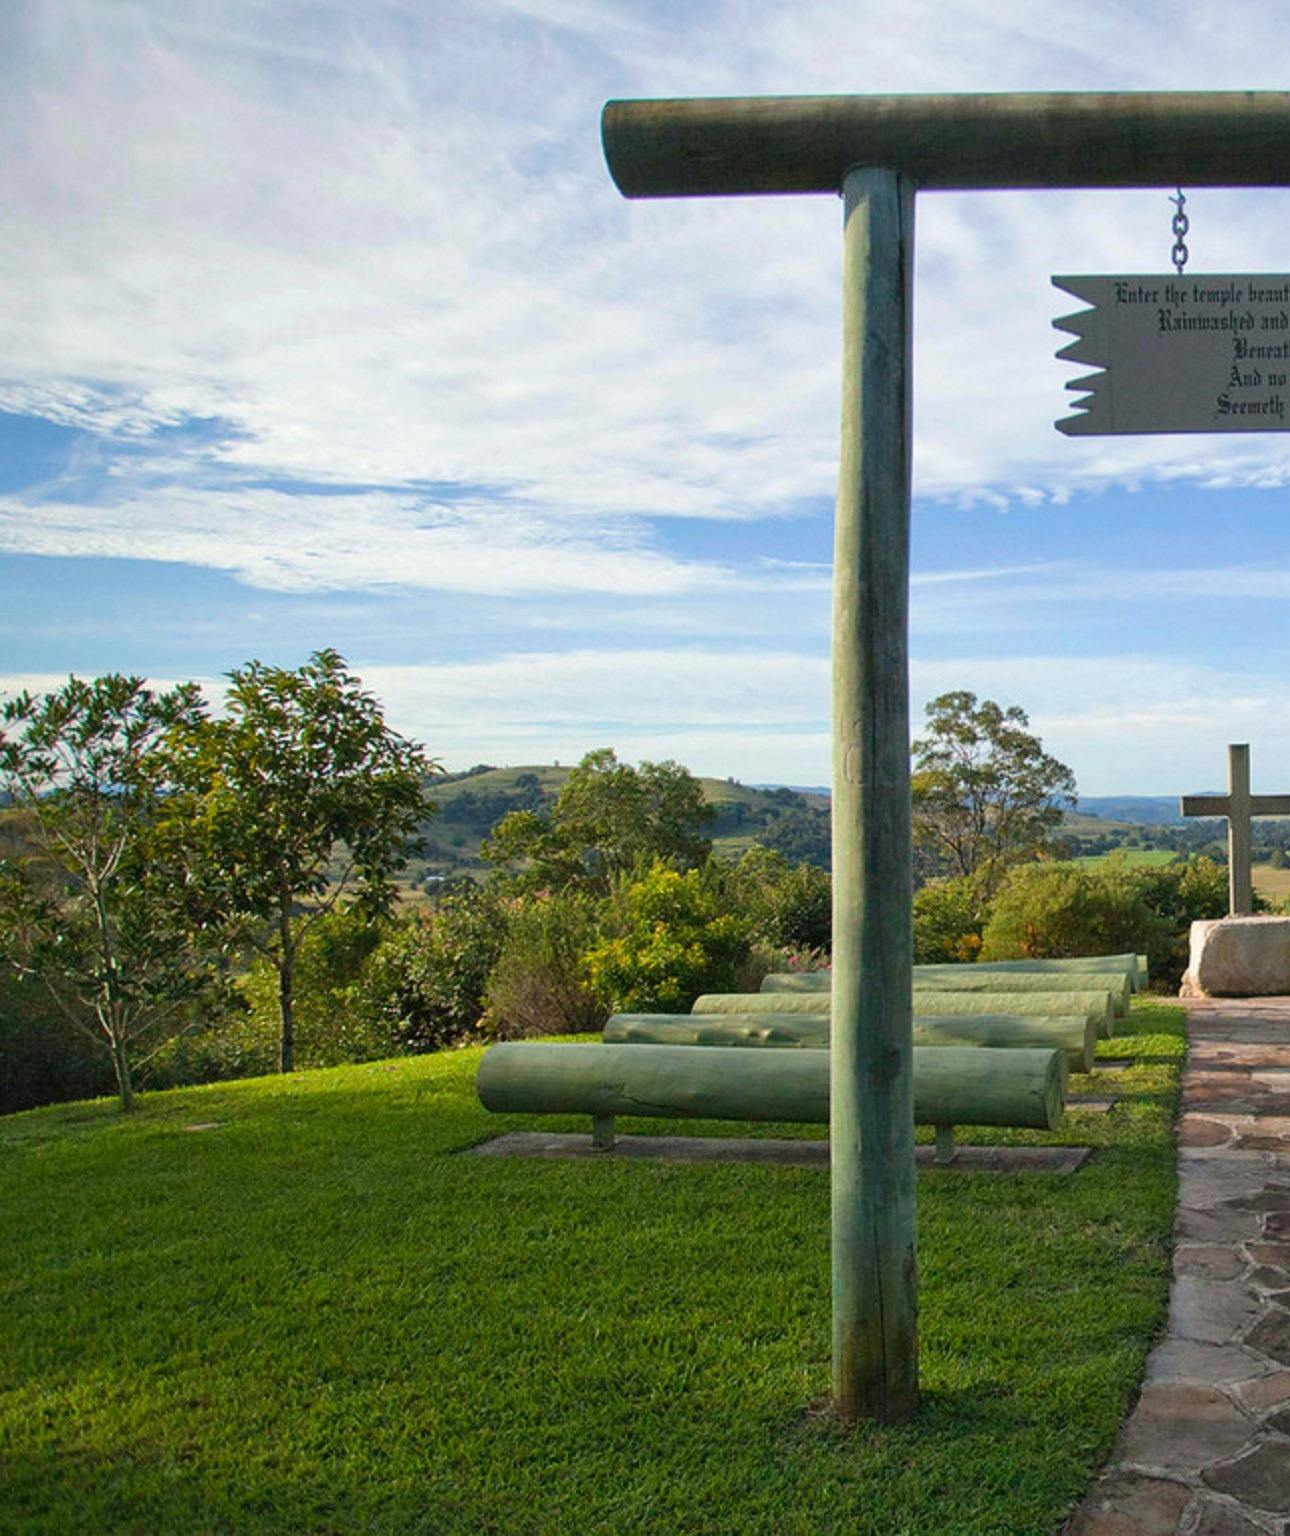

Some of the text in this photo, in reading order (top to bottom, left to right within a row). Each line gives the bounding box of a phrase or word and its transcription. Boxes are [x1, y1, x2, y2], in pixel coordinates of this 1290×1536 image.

[1113, 281, 1159, 306] Enter
[1165, 282, 1188, 308] the
[1193, 283, 1244, 306] temple
[1157, 308, 1255, 335] Rainwashed
[1260, 310, 1289, 330] and
[1227, 365, 1263, 389] And
[1267, 373, 1287, 387] no
[1213, 393, 1285, 420] Seemeth
